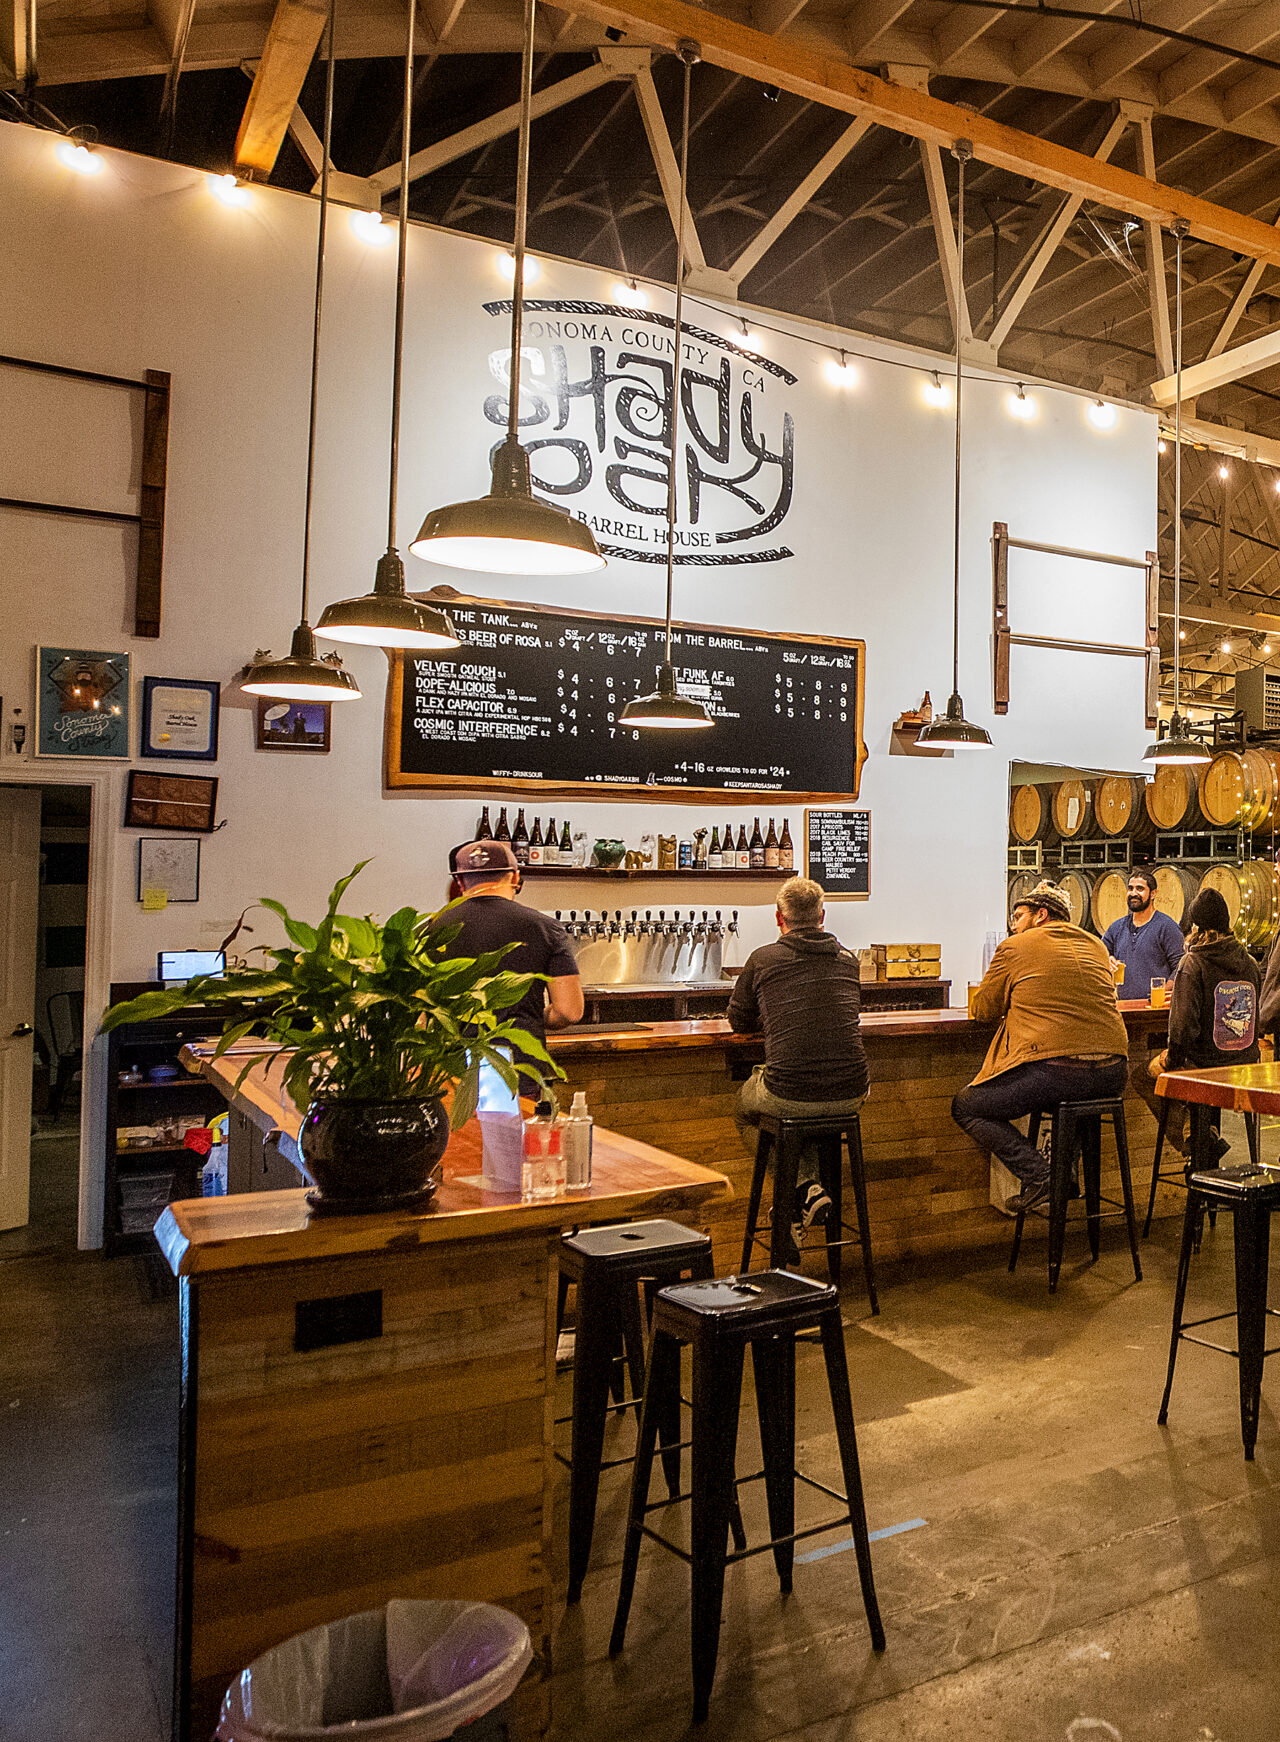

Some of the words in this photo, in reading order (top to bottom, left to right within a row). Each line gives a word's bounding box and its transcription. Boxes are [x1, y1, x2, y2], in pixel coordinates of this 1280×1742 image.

[522, 321, 614, 342] ONOMA
[622, 328, 709, 365] COUNTY
[742, 369, 766, 393] CA
[577, 510, 649, 542] BARREL
[653, 529, 712, 548] HOUSE
[453, 610, 475, 623] THE
[469, 631, 497, 643] BEER
[499, 633, 513, 644] OF
[515, 635, 542, 648] ROSA
[685, 634, 705, 647] THE
[607, 645, 615, 655] 6
[635, 647, 641, 658] 7
[414, 660, 456, 673] VELVET
[460, 664, 496, 677] COUCH
[683, 668, 708, 680] FUNK
[711, 671, 724, 681] AF
[415, 677, 496, 694] DOPE-ALICIOUS
[606, 677, 613, 688] 6
[633, 679, 641, 690] 7
[815, 680, 822, 690] 8
[840, 683, 847, 693] 9
[416, 696, 445, 709] FLEX
[447, 699, 504, 713] CAPACITOR
[608, 693, 616, 704] 6
[813, 695, 820, 705] 8
[840, 697, 847, 707] 9
[54, 708, 113, 731] Sonoma
[607, 712, 615, 723] 6
[814, 710, 821, 720] 8
[840, 712, 847, 722] 9
[61, 720, 110, 742] County
[414, 718, 454, 731] COSMIC
[458, 720, 538, 736] INTERFERENCE
[609, 728, 616, 739] 7
[632, 730, 640, 740] 8
